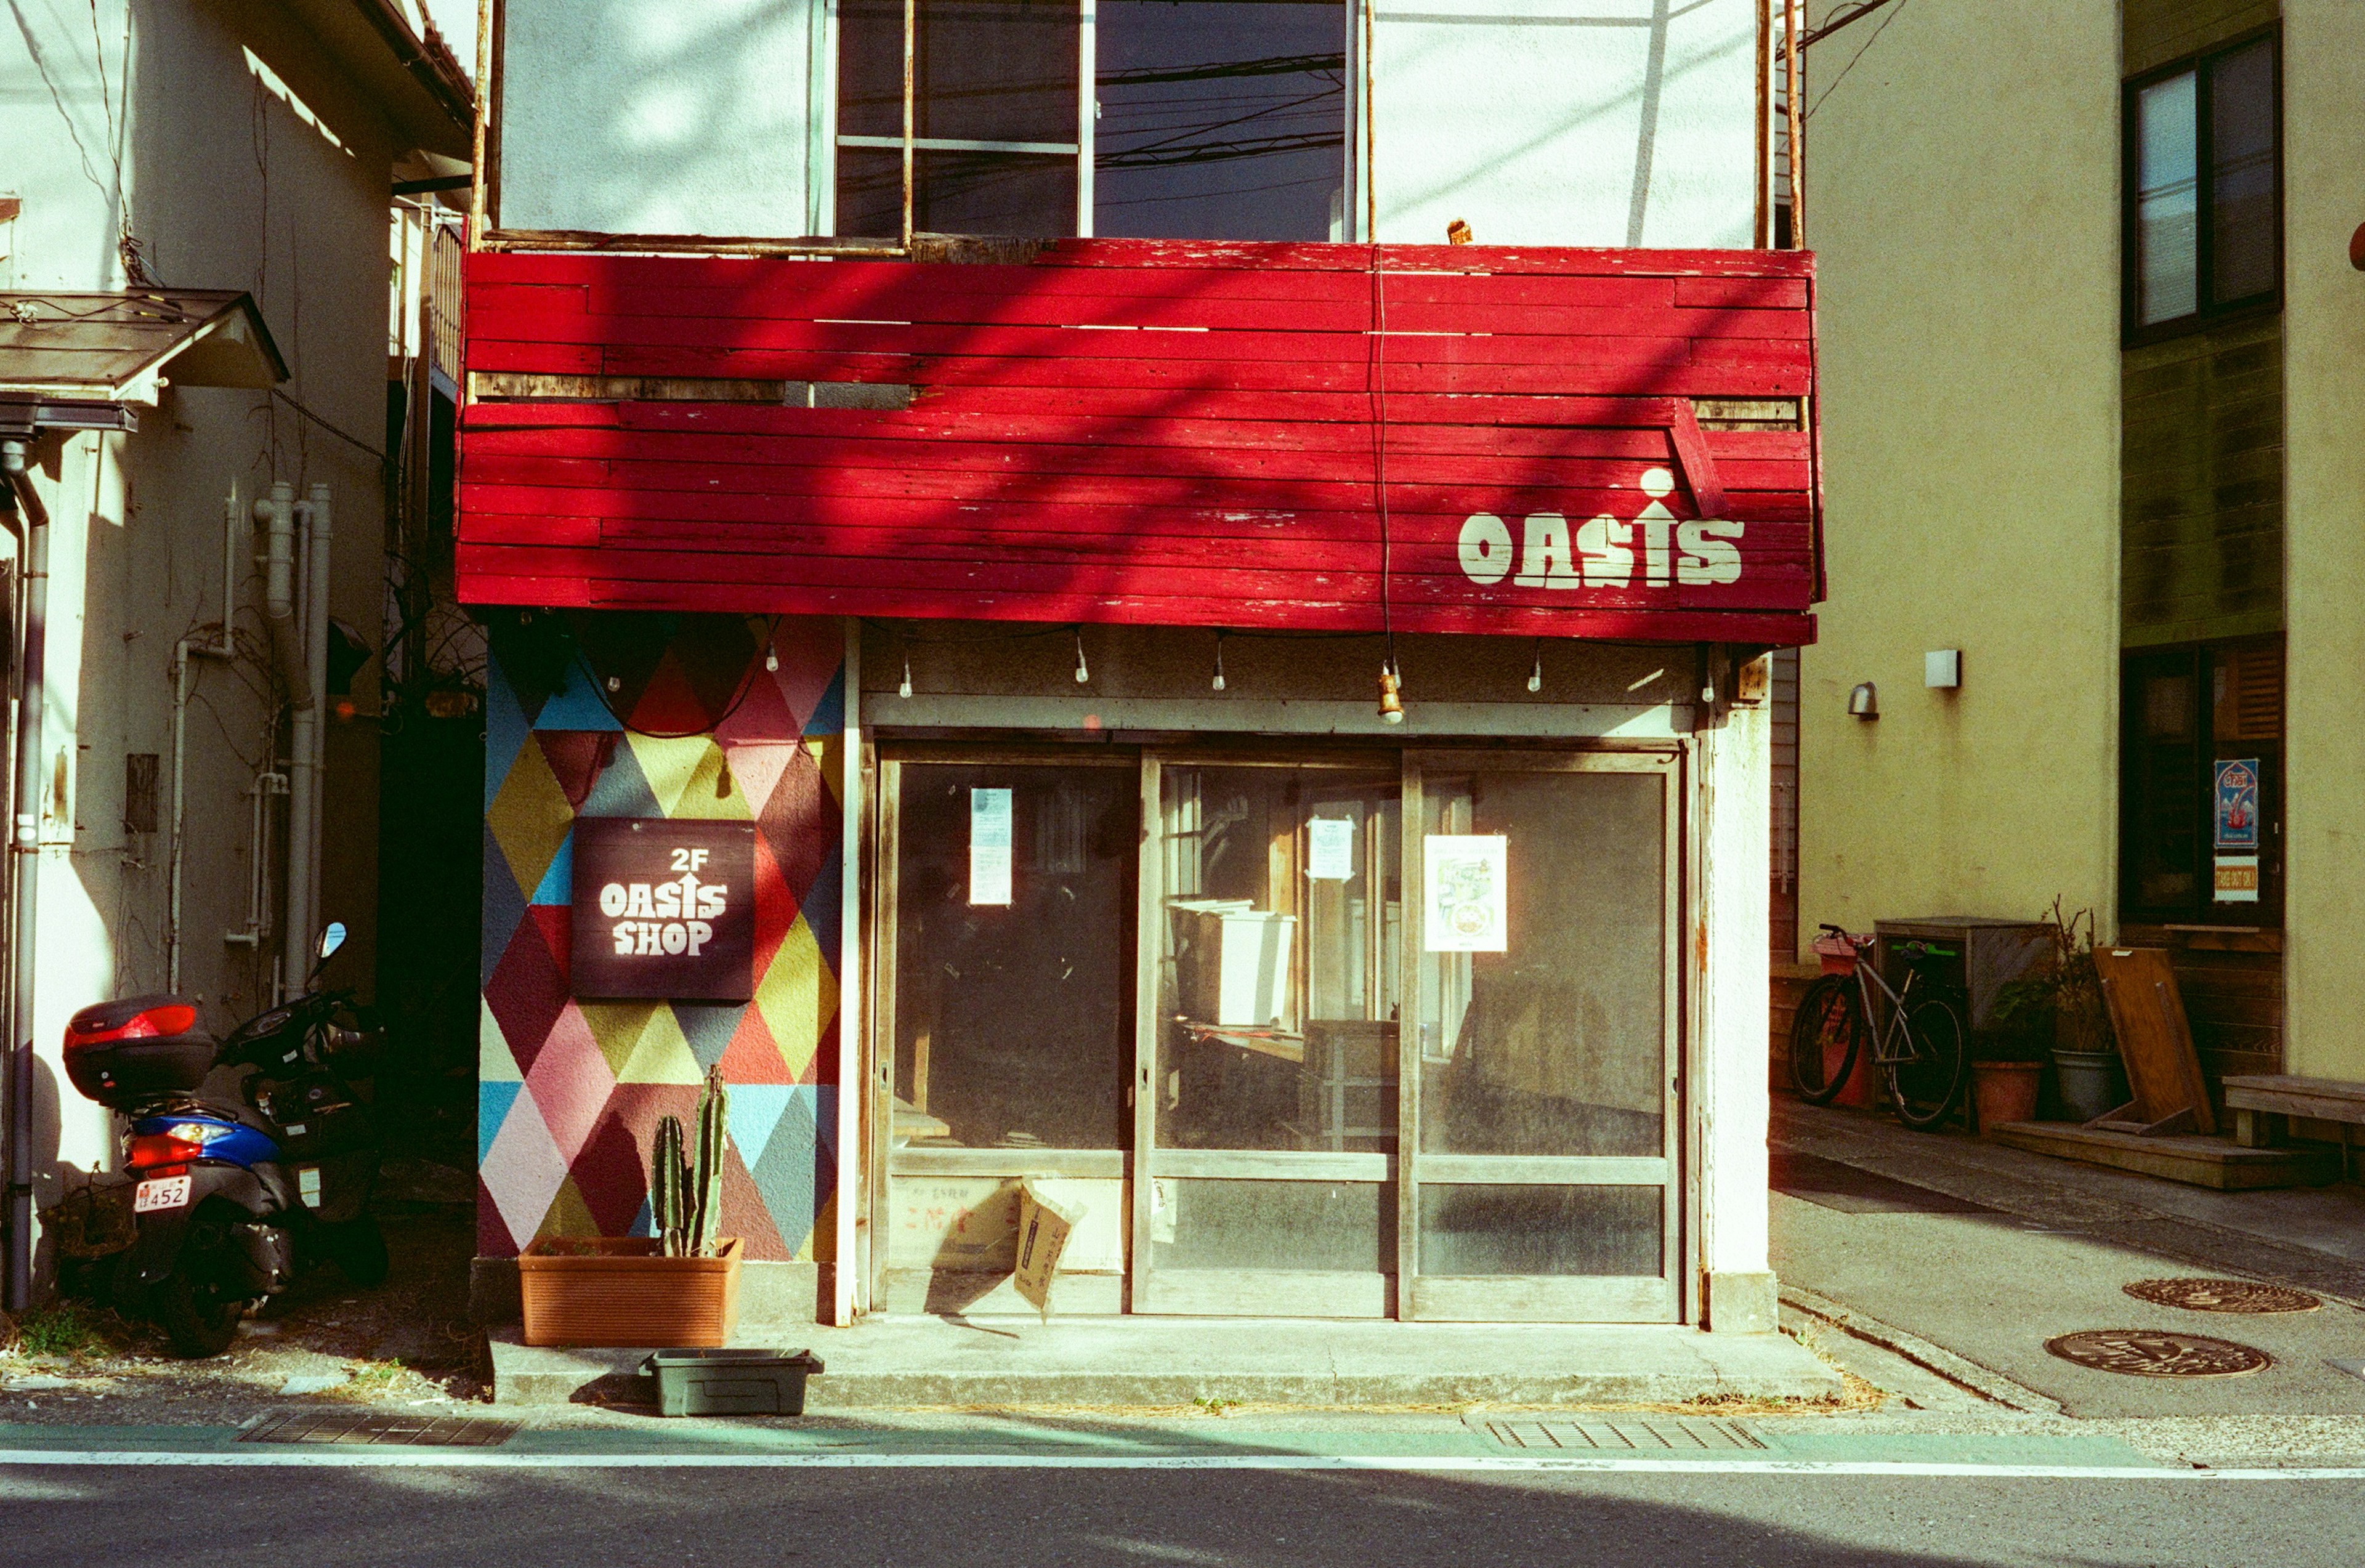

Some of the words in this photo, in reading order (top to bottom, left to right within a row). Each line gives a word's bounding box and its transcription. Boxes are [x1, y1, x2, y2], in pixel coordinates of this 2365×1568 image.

[670, 847, 709, 871] 2F
[599, 871, 728, 919] OASIS
[612, 921, 713, 956] SHOP
[151, 1188, 183, 1206] 452
